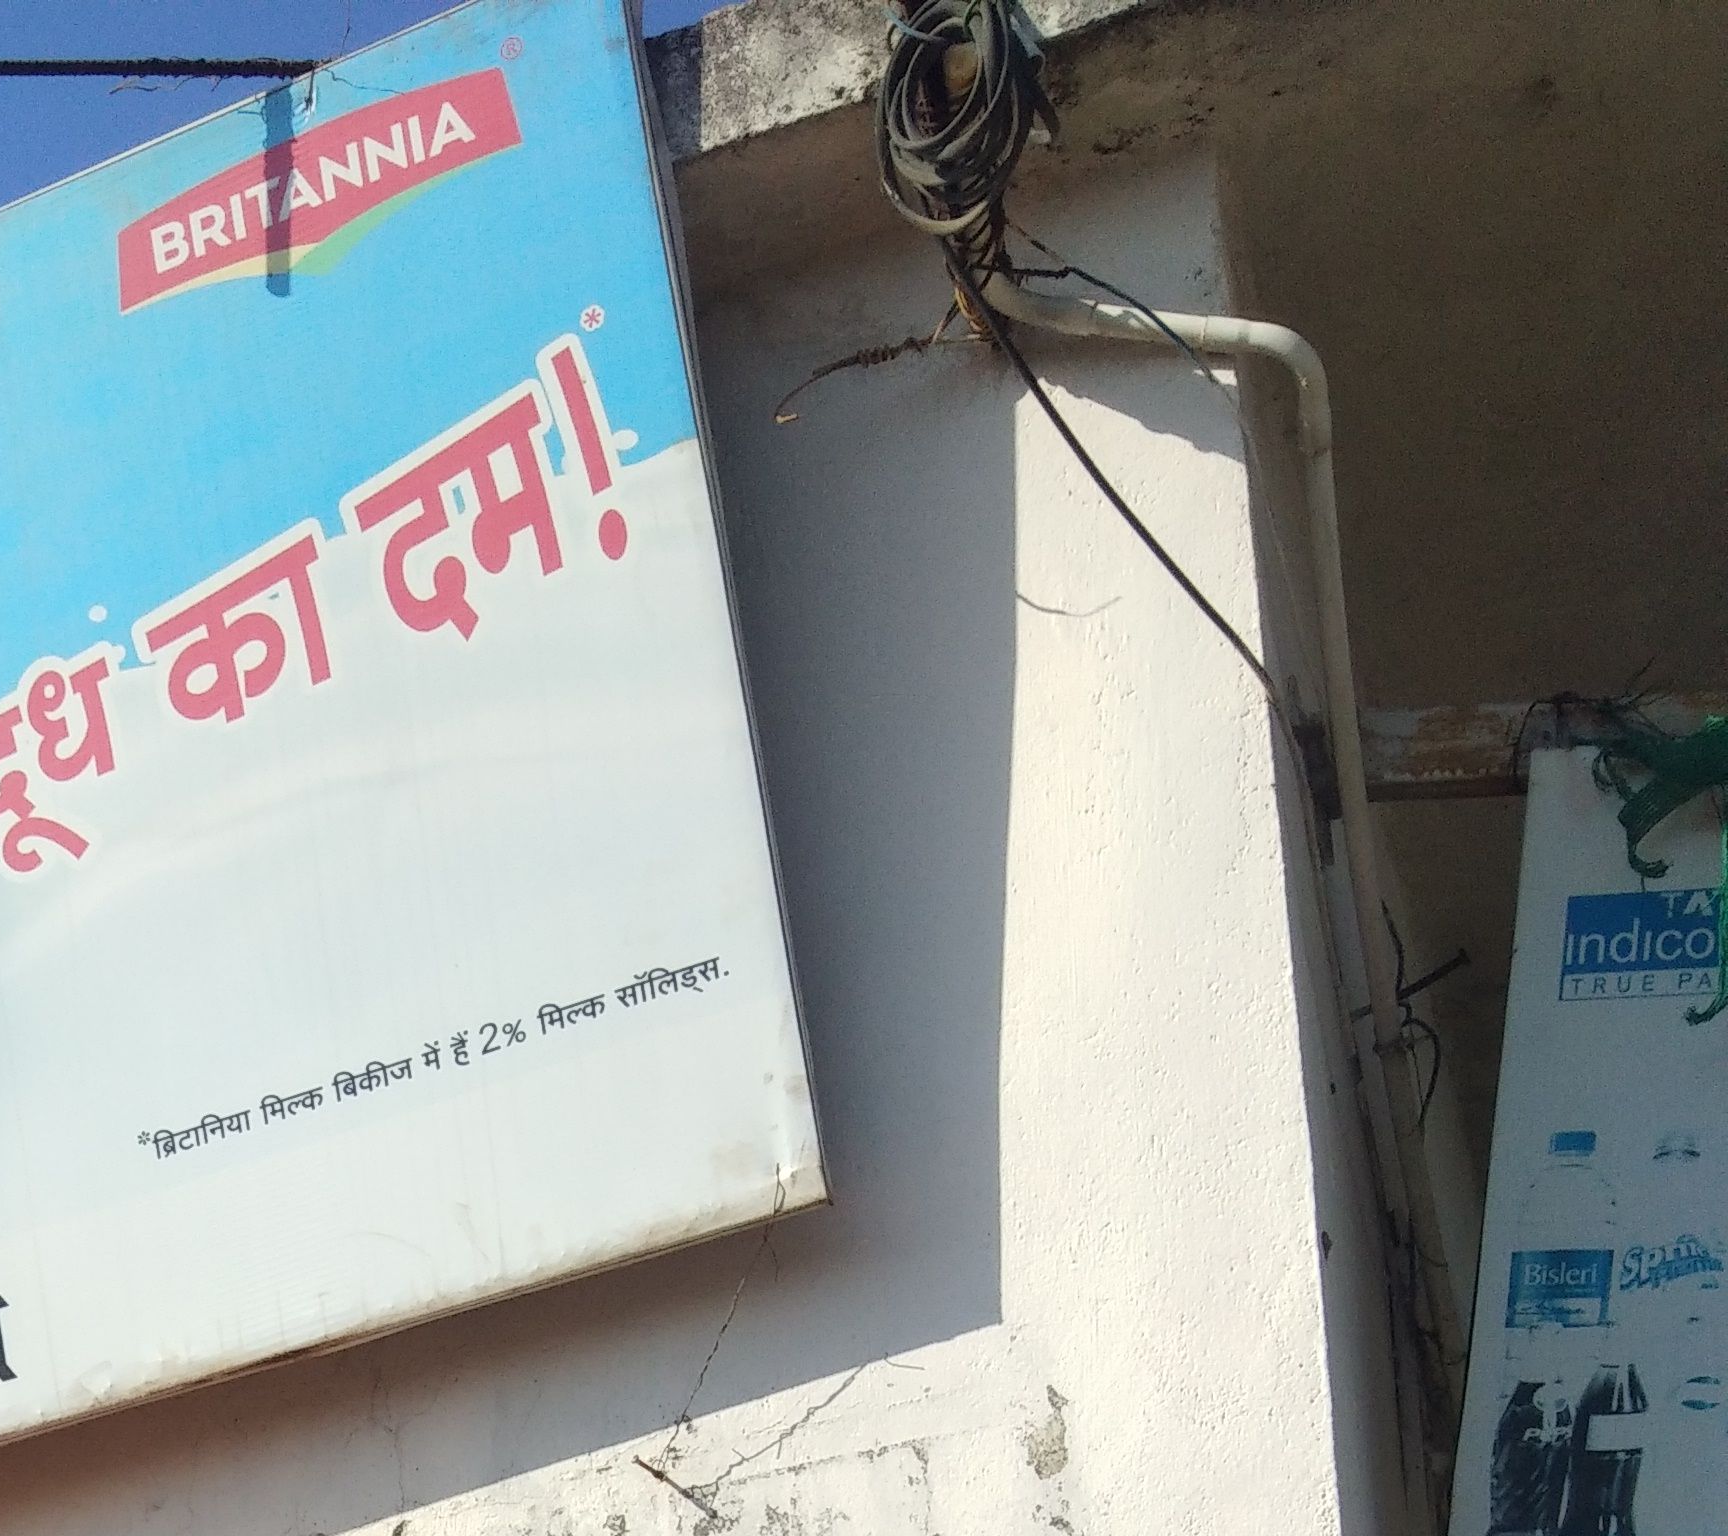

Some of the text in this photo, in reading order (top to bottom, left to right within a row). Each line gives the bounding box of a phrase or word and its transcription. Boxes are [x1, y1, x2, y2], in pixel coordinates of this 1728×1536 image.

[150, 101, 476, 274] BRITANNIA
[145, 533, 331, 722] का
[1564, 917, 1716, 967] indico
[1572, 972, 1713, 995] TRUE PA
[260, 1087, 324, 1125] मिल्क
[332, 1057, 413, 1102] बिकीज
[421, 1041, 442, 1070] में
[450, 1030, 471, 1066] हैं
[478, 1019, 527, 1055] 2%
[537, 994, 605, 1035] मिल्क
[1524, 1262, 1598, 1286] Bisleri
